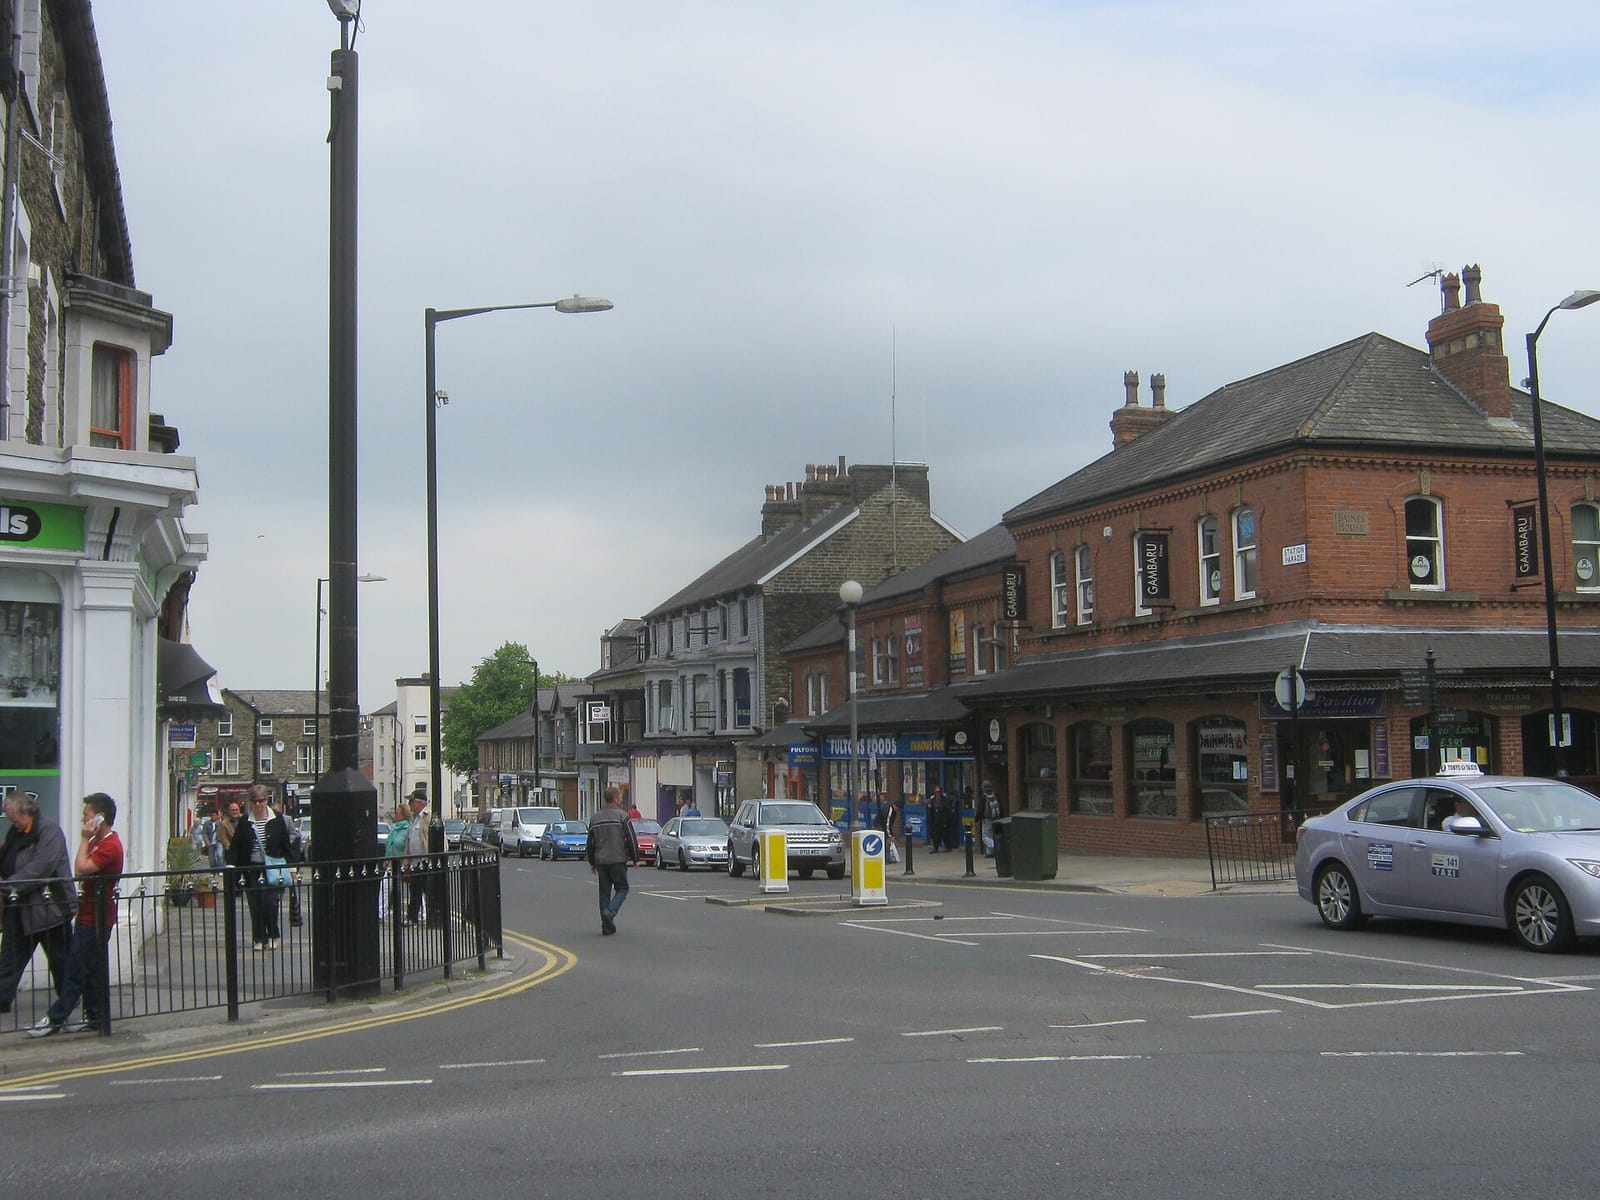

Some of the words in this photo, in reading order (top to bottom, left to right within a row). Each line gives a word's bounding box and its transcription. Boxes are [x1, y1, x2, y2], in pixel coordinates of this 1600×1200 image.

[1284, 546, 1304, 556] STATION
[1518, 517, 1529, 573] GAMBARU
[1285, 554, 1304, 563] PARADE
[1146, 543, 1158, 595] GAMBARU
[1007, 573, 1017, 618] GAMBARU
[1312, 693, 1376, 707] Pavilion
[867, 737, 897, 755] FOODS
[1447, 857, 1458, 868] 141
[1435, 867, 1457, 878] TAXI
